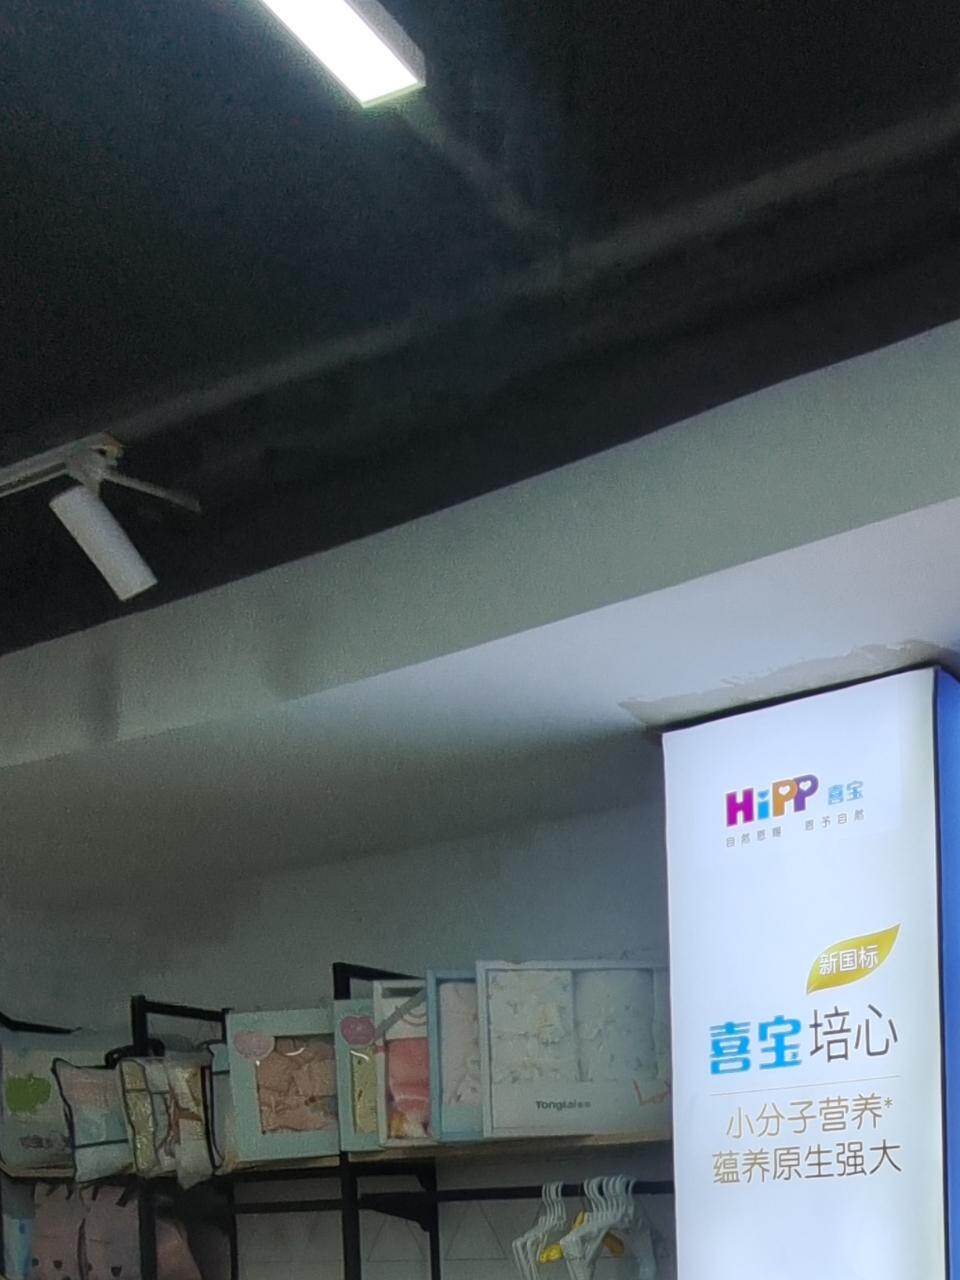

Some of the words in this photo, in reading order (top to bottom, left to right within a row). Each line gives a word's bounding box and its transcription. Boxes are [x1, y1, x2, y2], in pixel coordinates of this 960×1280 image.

[726, 774, 819, 827] HiPP
[828, 780, 864, 805] 喜宝
[817, 944, 880, 977] 新国标
[709, 1004, 898, 1075] 喜宝培心
[712, 1138, 902, 1184] 蕴养原生强大
